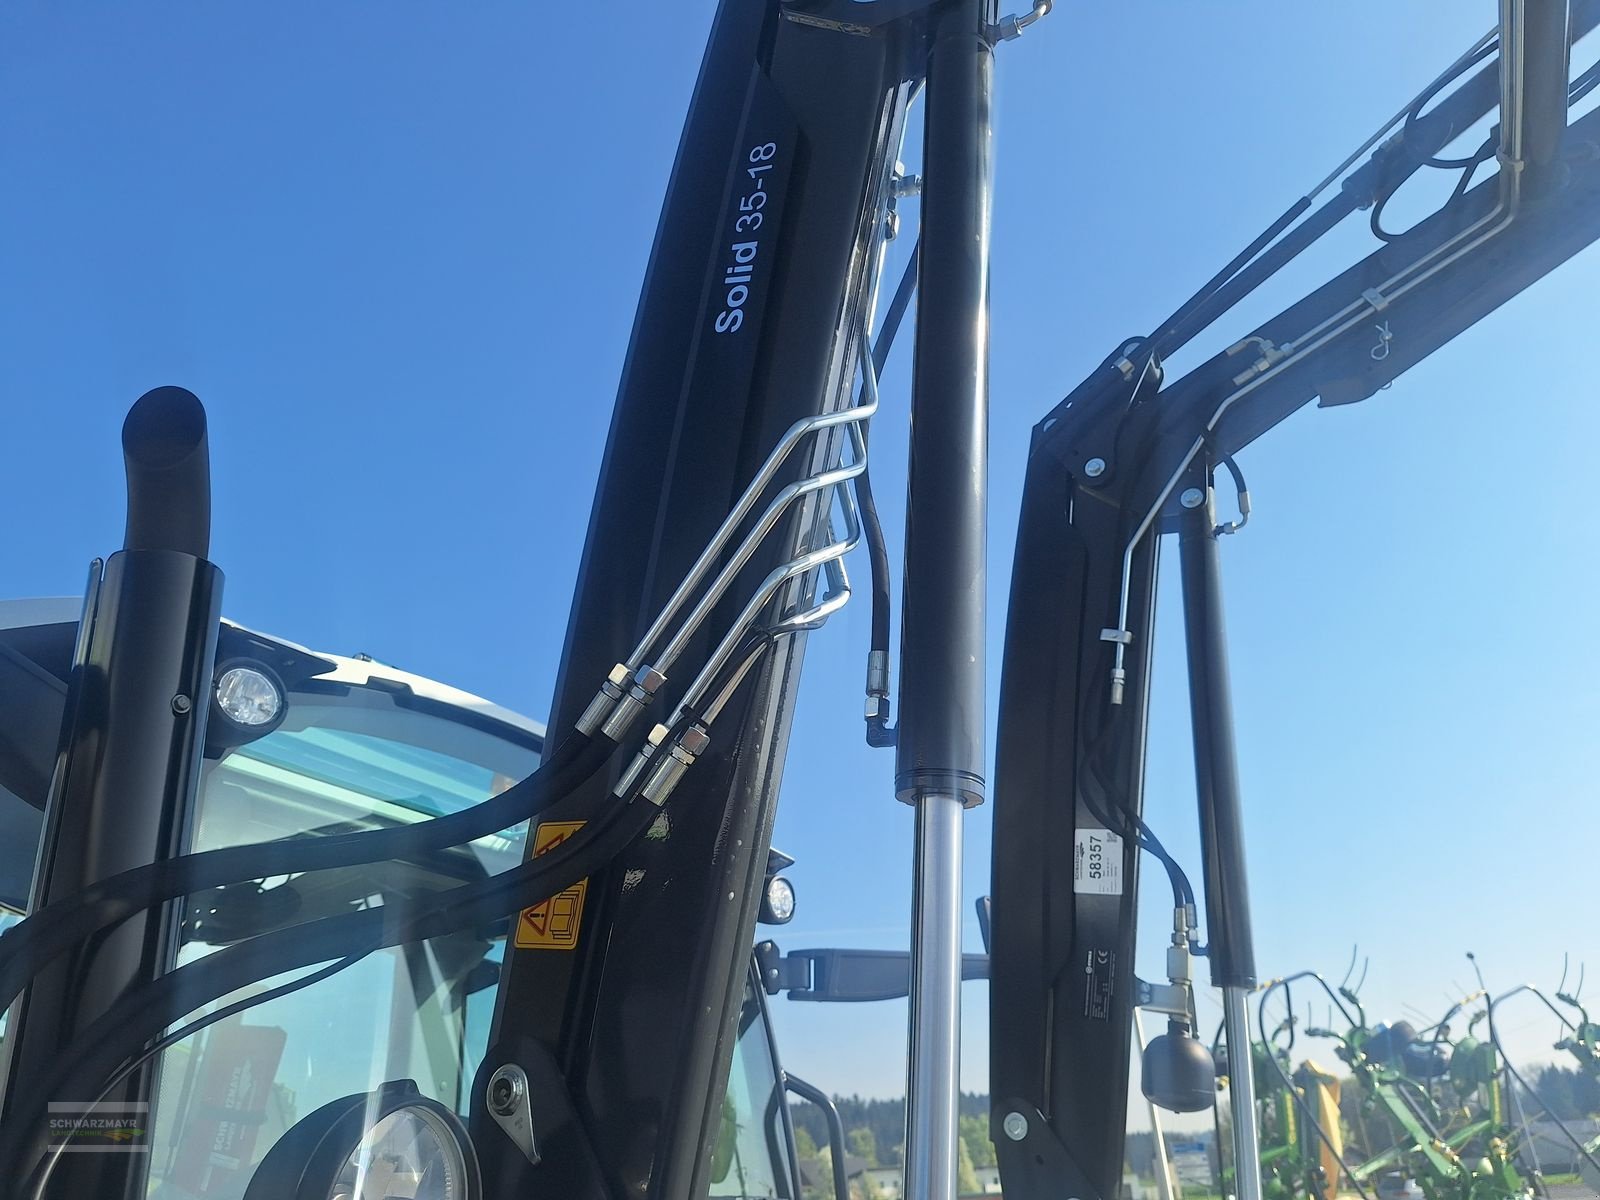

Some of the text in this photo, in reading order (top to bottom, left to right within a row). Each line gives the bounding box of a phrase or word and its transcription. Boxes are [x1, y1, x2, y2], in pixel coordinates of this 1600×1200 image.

[715, 142, 777, 334] Solid 35-18
[1089, 835, 1102, 880] 58357
